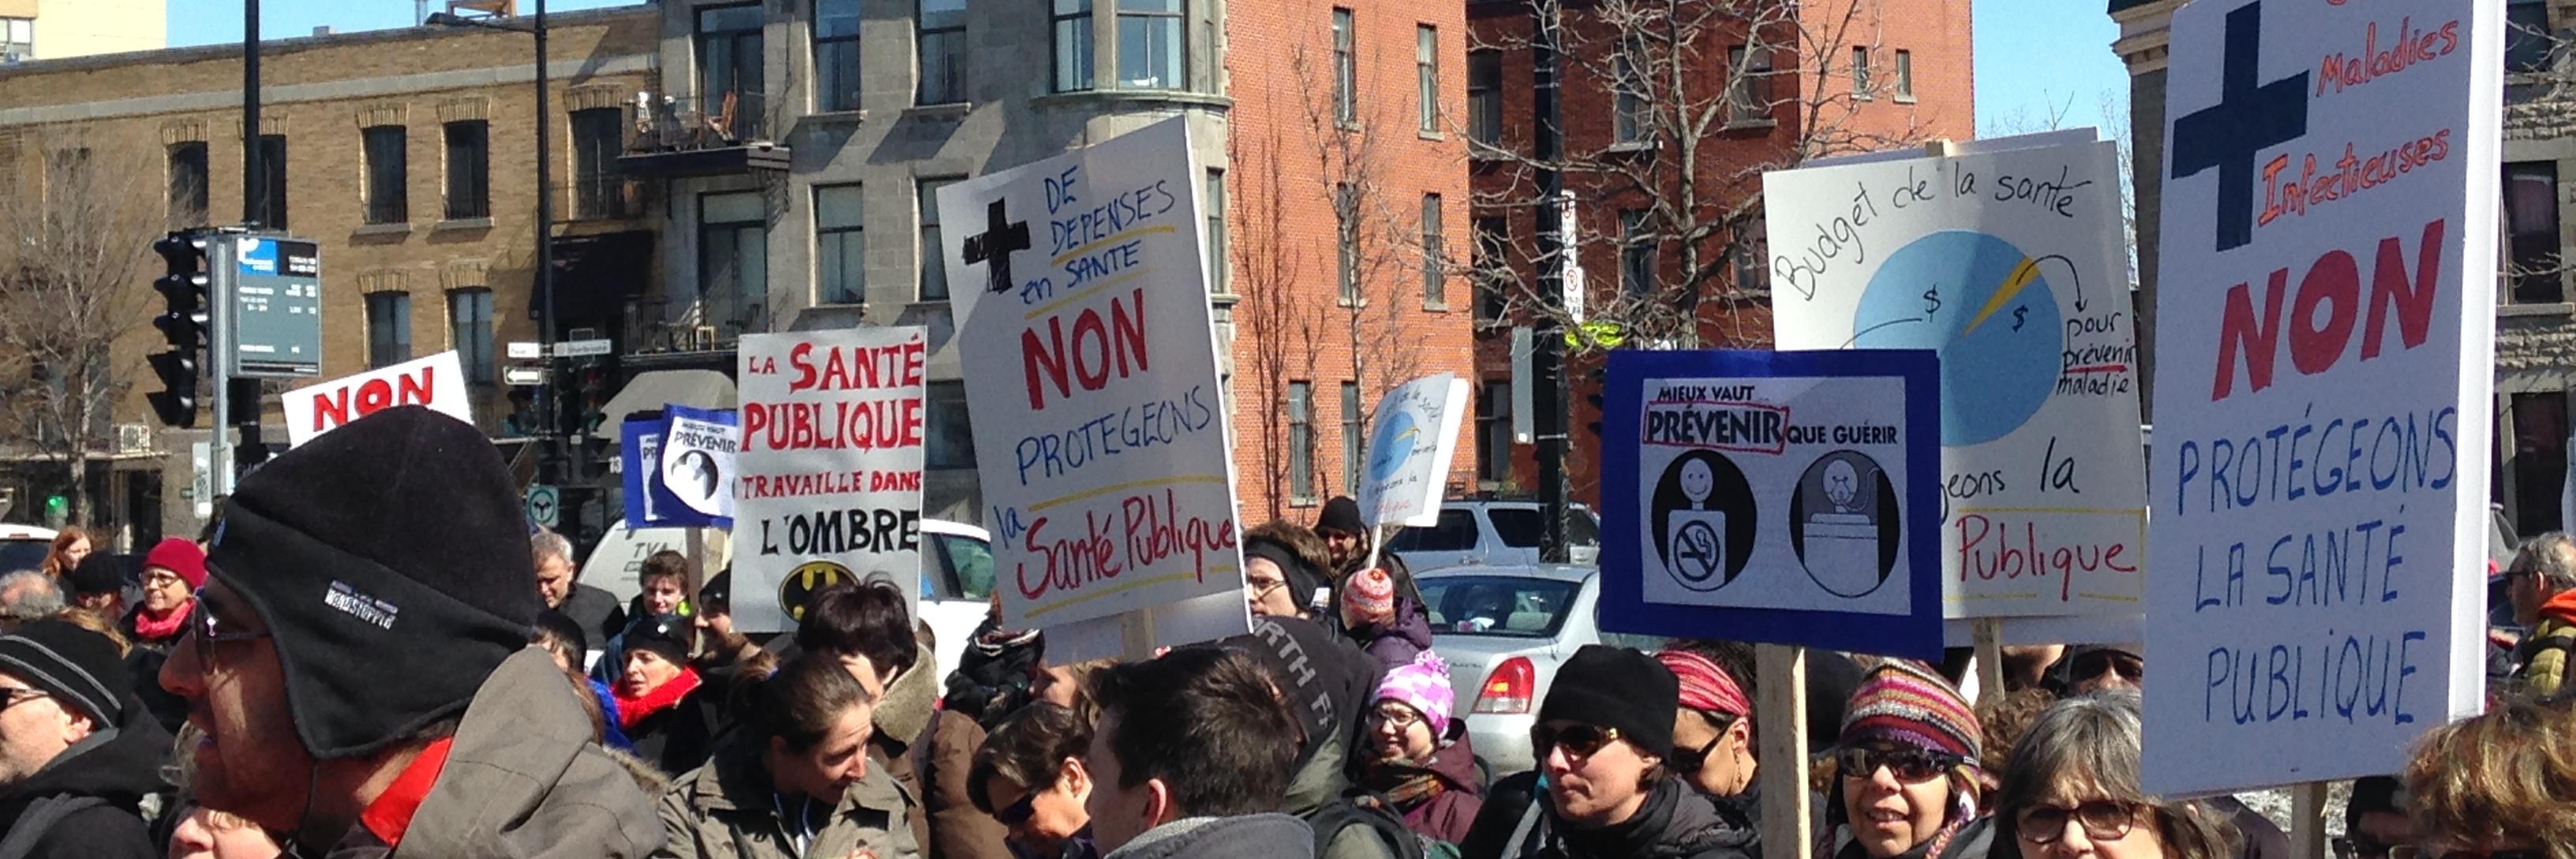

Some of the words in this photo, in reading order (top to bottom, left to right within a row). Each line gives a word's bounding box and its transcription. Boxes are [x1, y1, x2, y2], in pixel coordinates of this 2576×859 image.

[2316, 17, 2458, 97] Maladies
[1044, 165, 1080, 214] DE
[2258, 128, 2451, 227] Infectieuses
[1050, 179, 1176, 256] DEPENSES
[1775, 181, 1878, 301] Budget
[1893, 165, 1937, 210] de
[1954, 161, 1977, 198] la
[1020, 275, 1053, 305] en
[1065, 239, 1142, 289] SANTE
[1923, 284, 1941, 327] $
[2066, 312, 2121, 352] pour
[2211, 218, 2445, 401] NON
[749, 356, 777, 374] LA
[789, 332, 925, 395] SANTÉ
[1021, 287, 1148, 410] NON
[313, 366, 434, 431] NON
[1657, 386, 1706, 401] MIEUX
[1711, 385, 1756, 401] VAUT
[2056, 368, 2129, 396] maladie
[674, 431, 736, 454] PRÉVENIR
[740, 397, 923, 454] PUBLIQUE
[1016, 385, 1211, 486] PROTEGEONS
[1646, 405, 1784, 445] PRÉVENIR
[1786, 424, 1827, 446] QUE
[1832, 420, 1898, 445] GUÉRIR
[741, 471, 863, 500] TRAVAILLE
[870, 470, 922, 493] DANS
[2039, 435, 2081, 494] la
[2177, 401, 2456, 516] PROTÉGEONS
[760, 509, 920, 556] L'OMBRE
[994, 505, 1028, 550] la
[1017, 510, 1123, 600] Santé
[1121, 487, 1237, 584] Publique
[1955, 514, 2138, 603] Publique
[2195, 543, 2245, 612] LA
[2265, 503, 2406, 607] SANTÉ
[2206, 629, 2426, 726] PUBLIQUE
